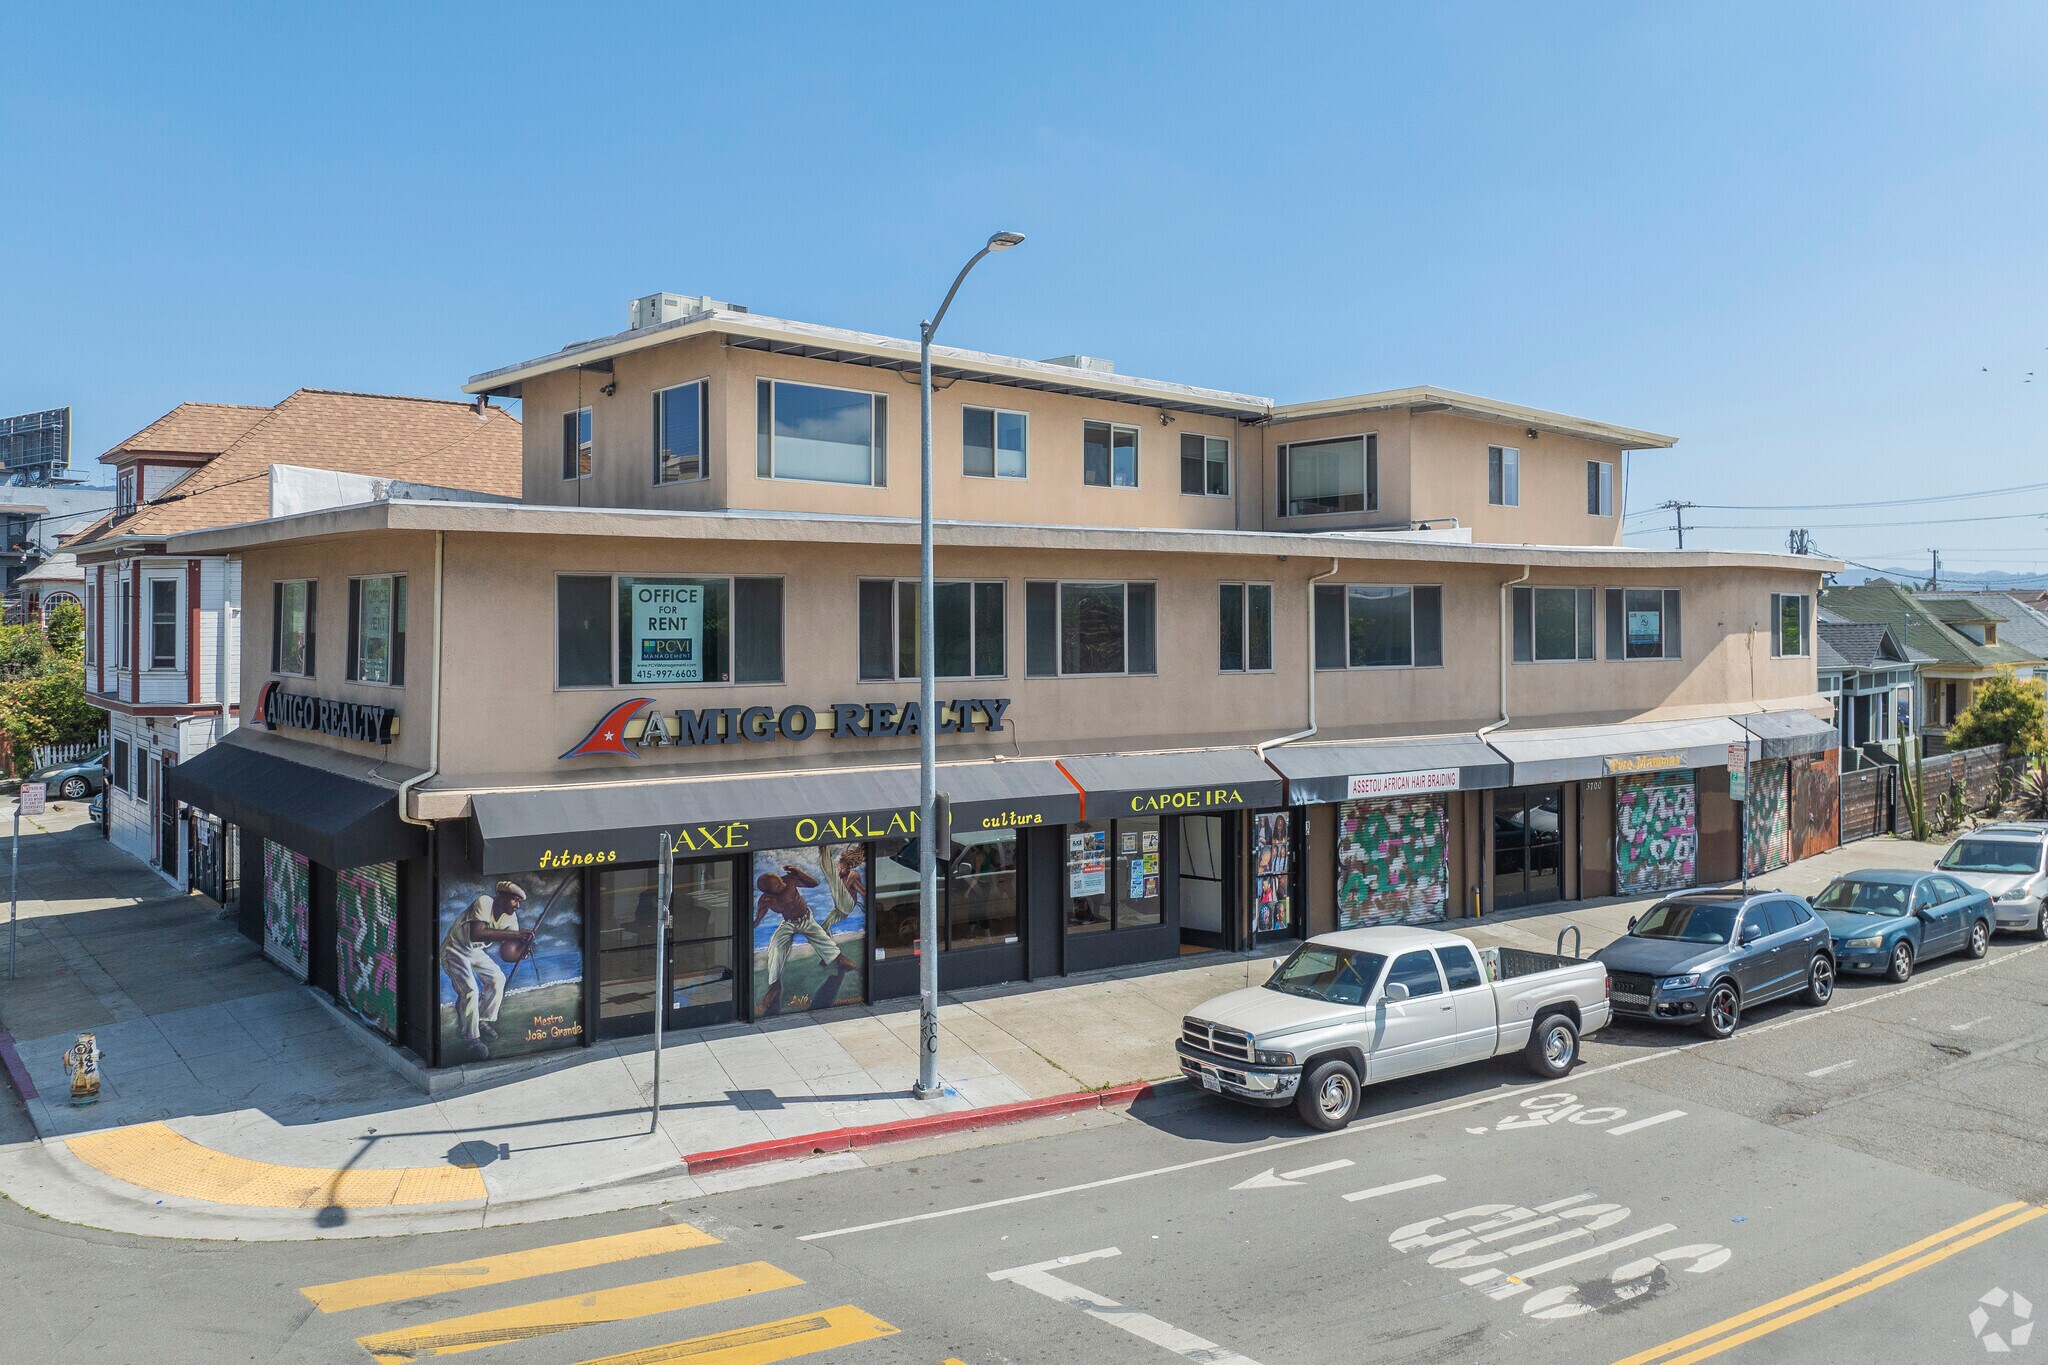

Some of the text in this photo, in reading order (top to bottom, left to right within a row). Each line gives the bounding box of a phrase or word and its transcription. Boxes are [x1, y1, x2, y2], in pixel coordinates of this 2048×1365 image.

[639, 589, 697, 603] OFFICE
[659, 606, 677, 614] FOR
[649, 617, 687, 630] RENT
[656, 640, 690, 653] PCVI
[636, 670, 697, 678] 415-997-6603
[267, 692, 386, 745] AMIGO REALTY
[636, 698, 1011, 747] AMIGO REALTY
[1353, 772, 1456, 794] ASSETOU AFRICAN HAIR BRAIDING
[1586, 782, 1601, 790] 3700
[540, 810, 1042, 868] fitness AXÉ OAKLAN cultura
[534, 1015, 564, 1026] Mestre
[526, 1021, 583, 1041] João Grande
